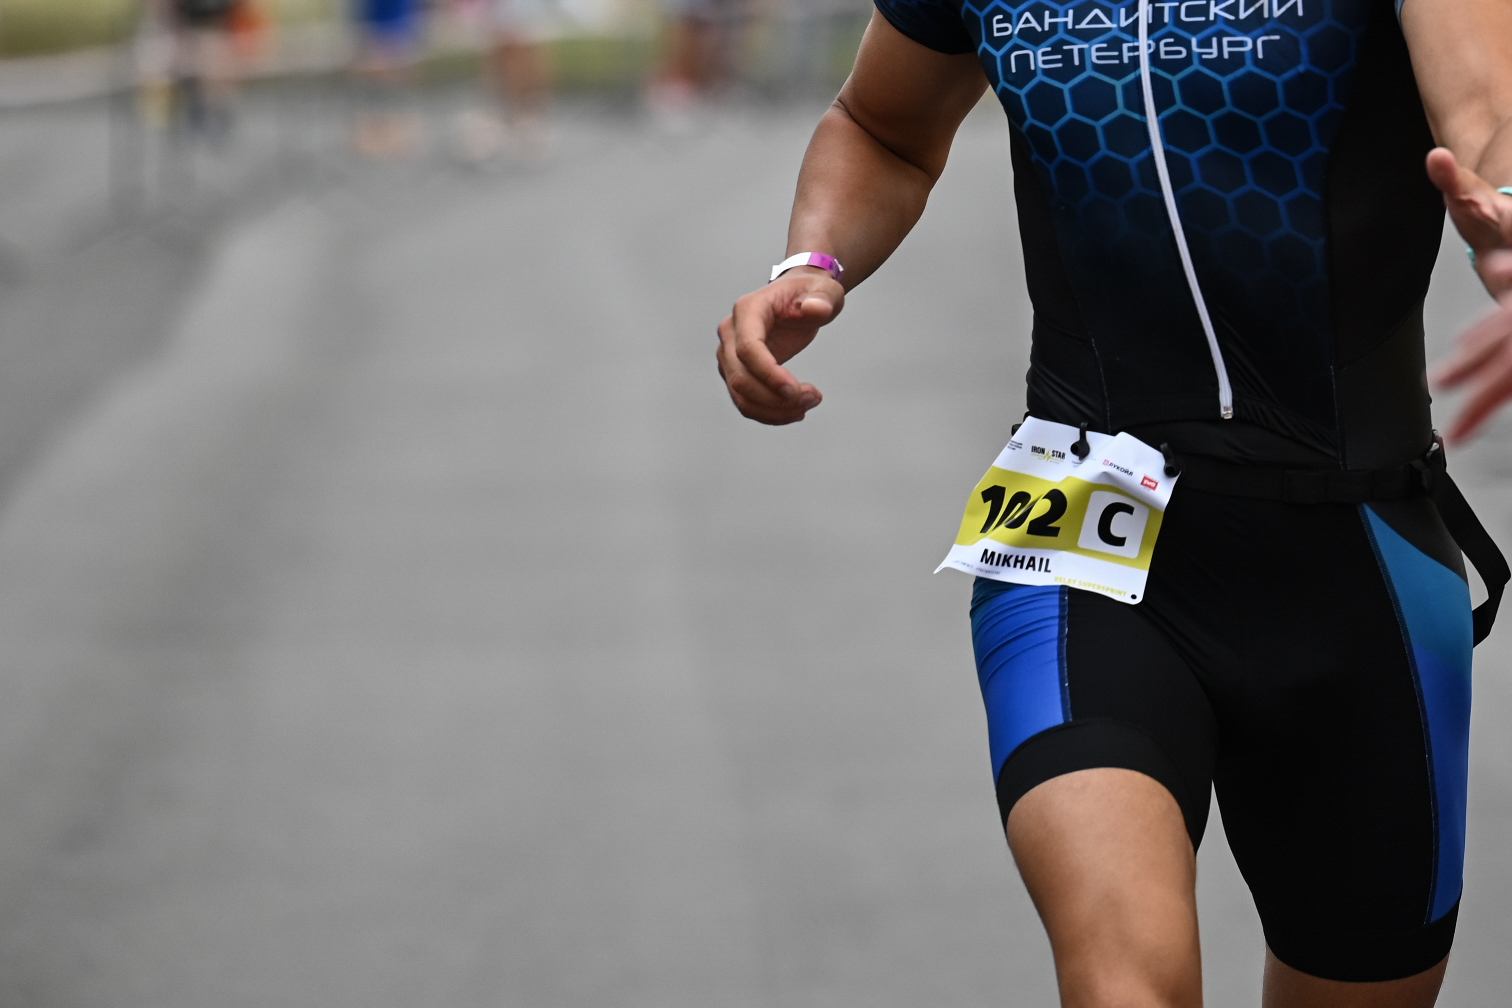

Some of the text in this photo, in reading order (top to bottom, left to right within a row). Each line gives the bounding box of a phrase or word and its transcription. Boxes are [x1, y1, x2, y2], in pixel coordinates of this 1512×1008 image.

[1010, 35, 1281, 74] ПЕТЕРБУРГ
[1031, 445, 1046, 455] IRON
[1051, 449, 1066, 460] STAR
[979, 484, 1068, 538] 102
[1097, 501, 1135, 547] C
[980, 548, 1052, 573] MIKHAIL
[1054, 576, 1077, 585] RELAY
